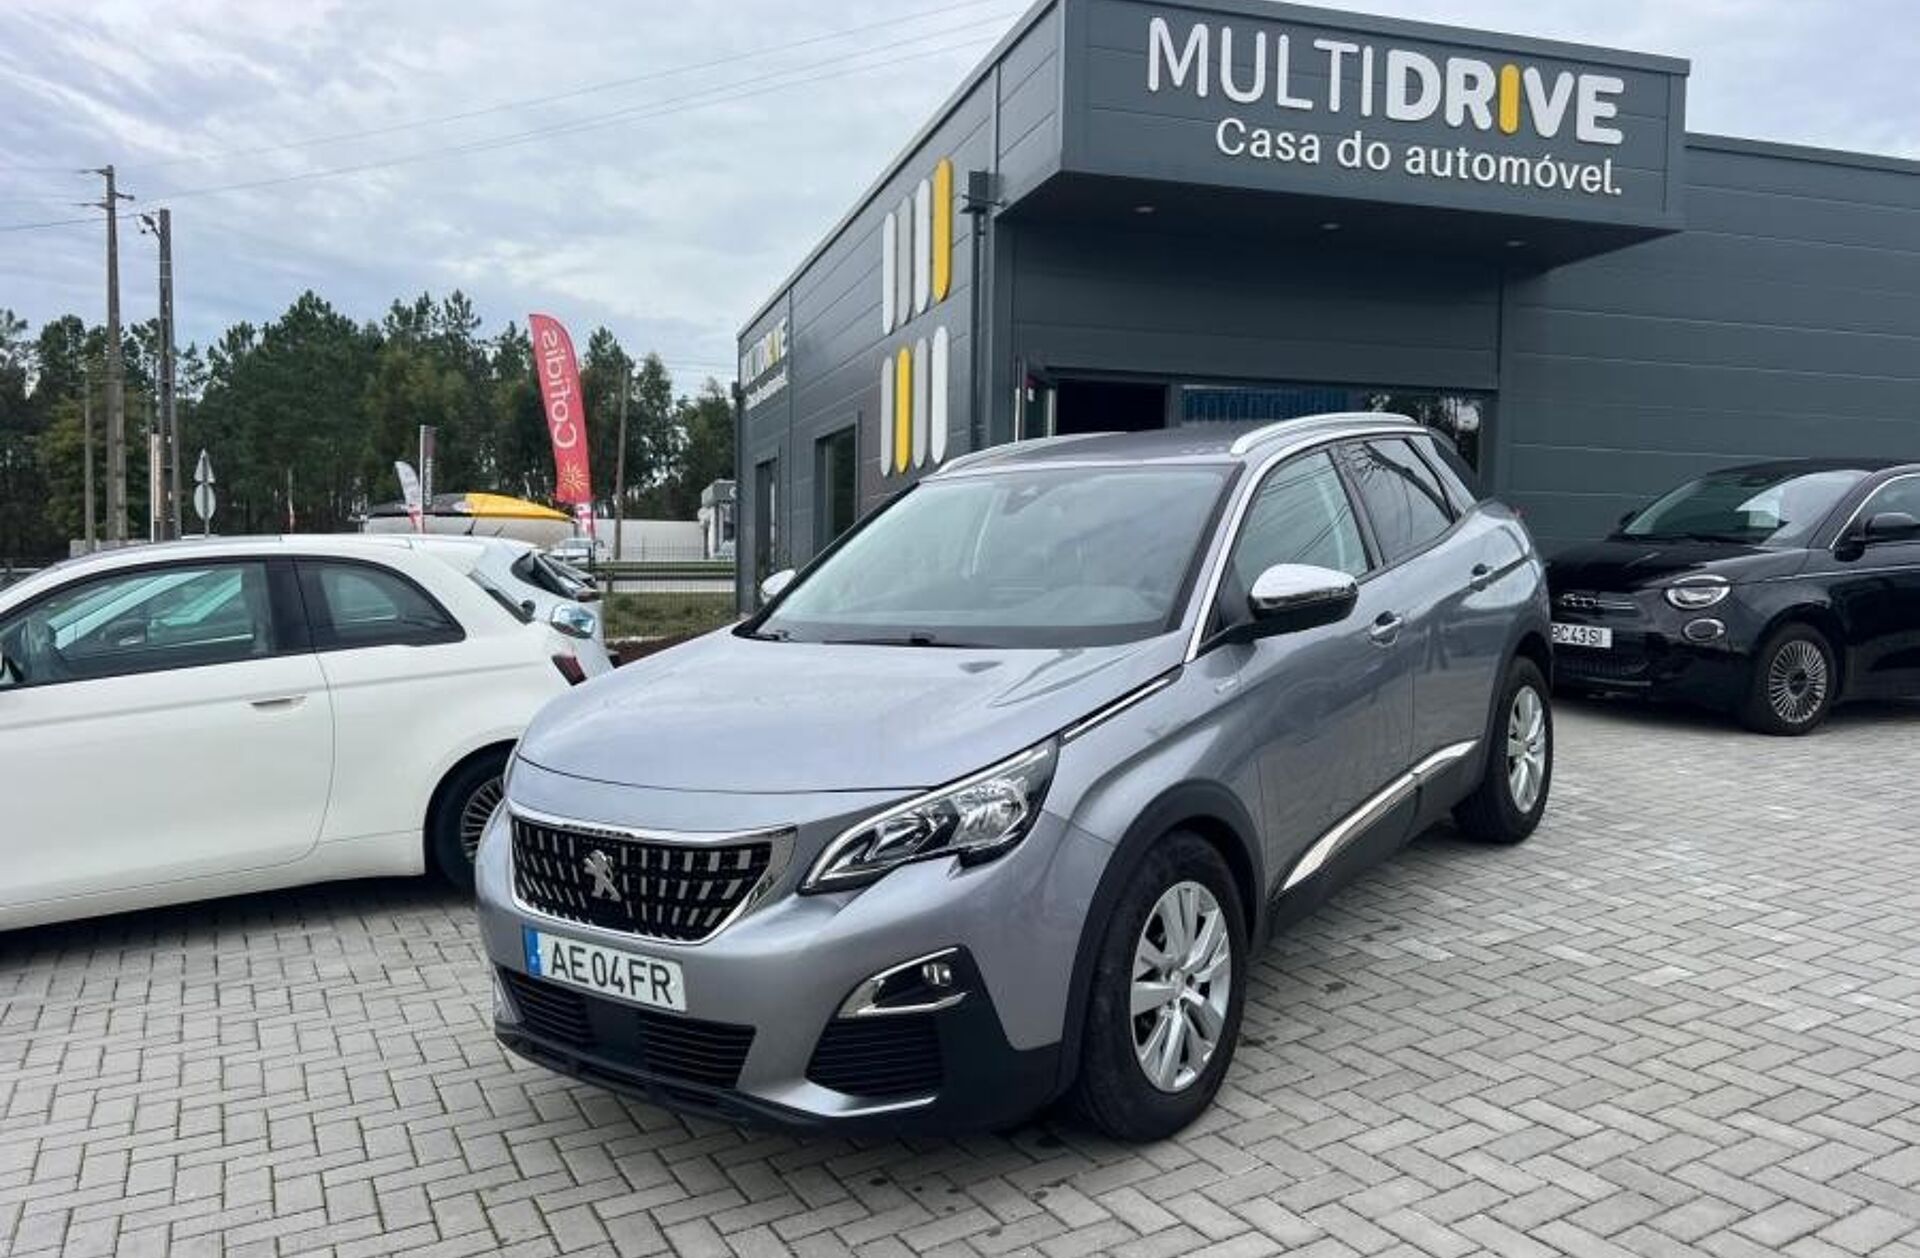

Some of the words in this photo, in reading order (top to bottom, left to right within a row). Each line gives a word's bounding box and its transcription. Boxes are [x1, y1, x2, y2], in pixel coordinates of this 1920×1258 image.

[1148, 17, 1624, 145] MULTIDRIVE
[1216, 118, 1320, 164] Casa
[1337, 131, 1391, 171] do
[1405, 142, 1623, 195] automóvel.
[551, 942, 673, 1005] AE04FR
